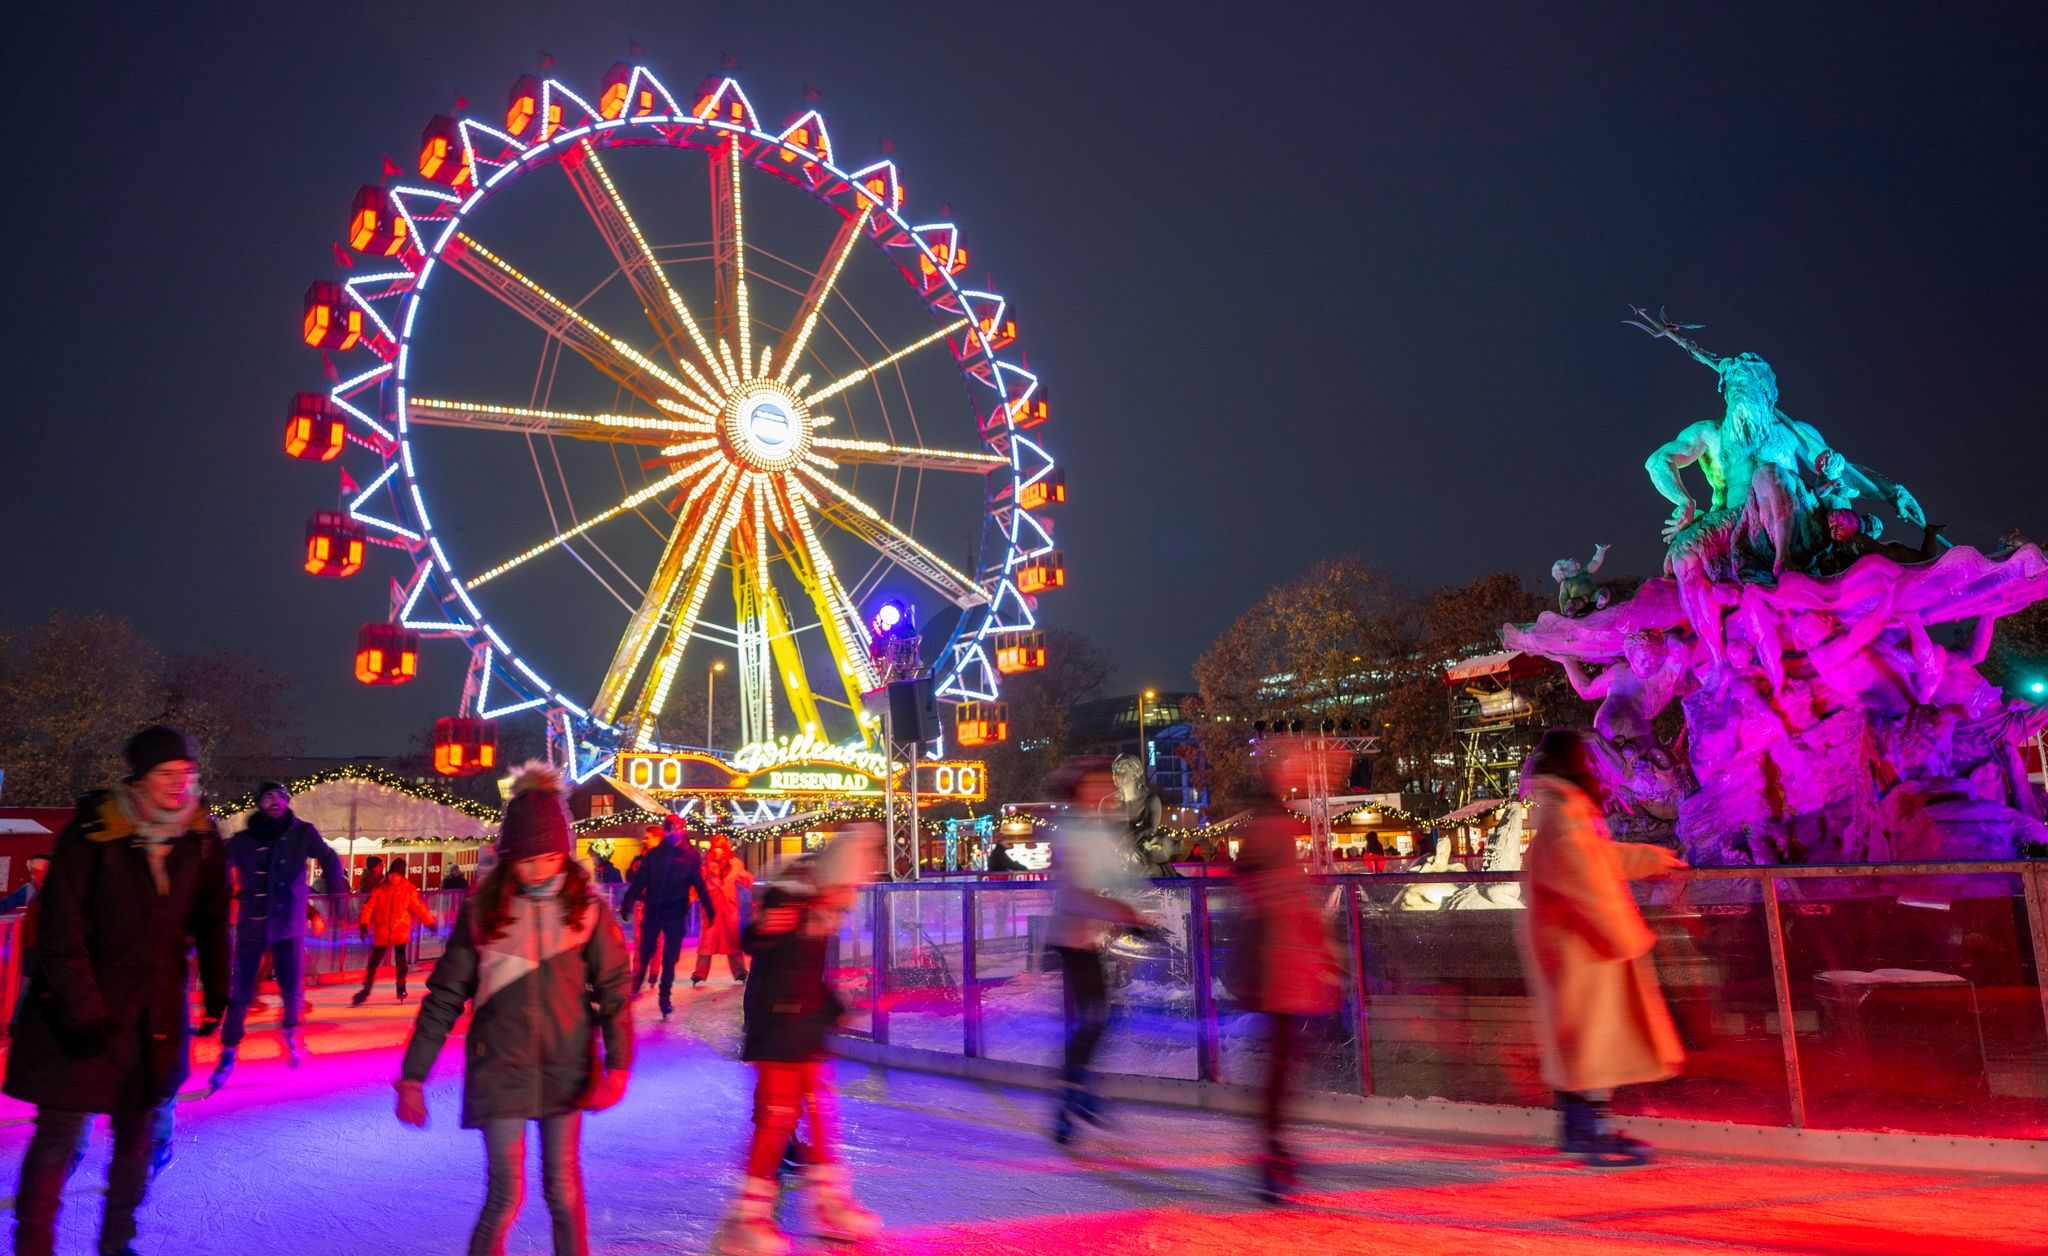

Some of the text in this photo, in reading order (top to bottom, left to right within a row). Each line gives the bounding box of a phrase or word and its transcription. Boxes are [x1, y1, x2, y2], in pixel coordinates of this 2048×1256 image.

[769, 772, 869, 790] RIESENRAD
[409, 866, 423, 874] 162
[427, 865, 440, 873] 163
